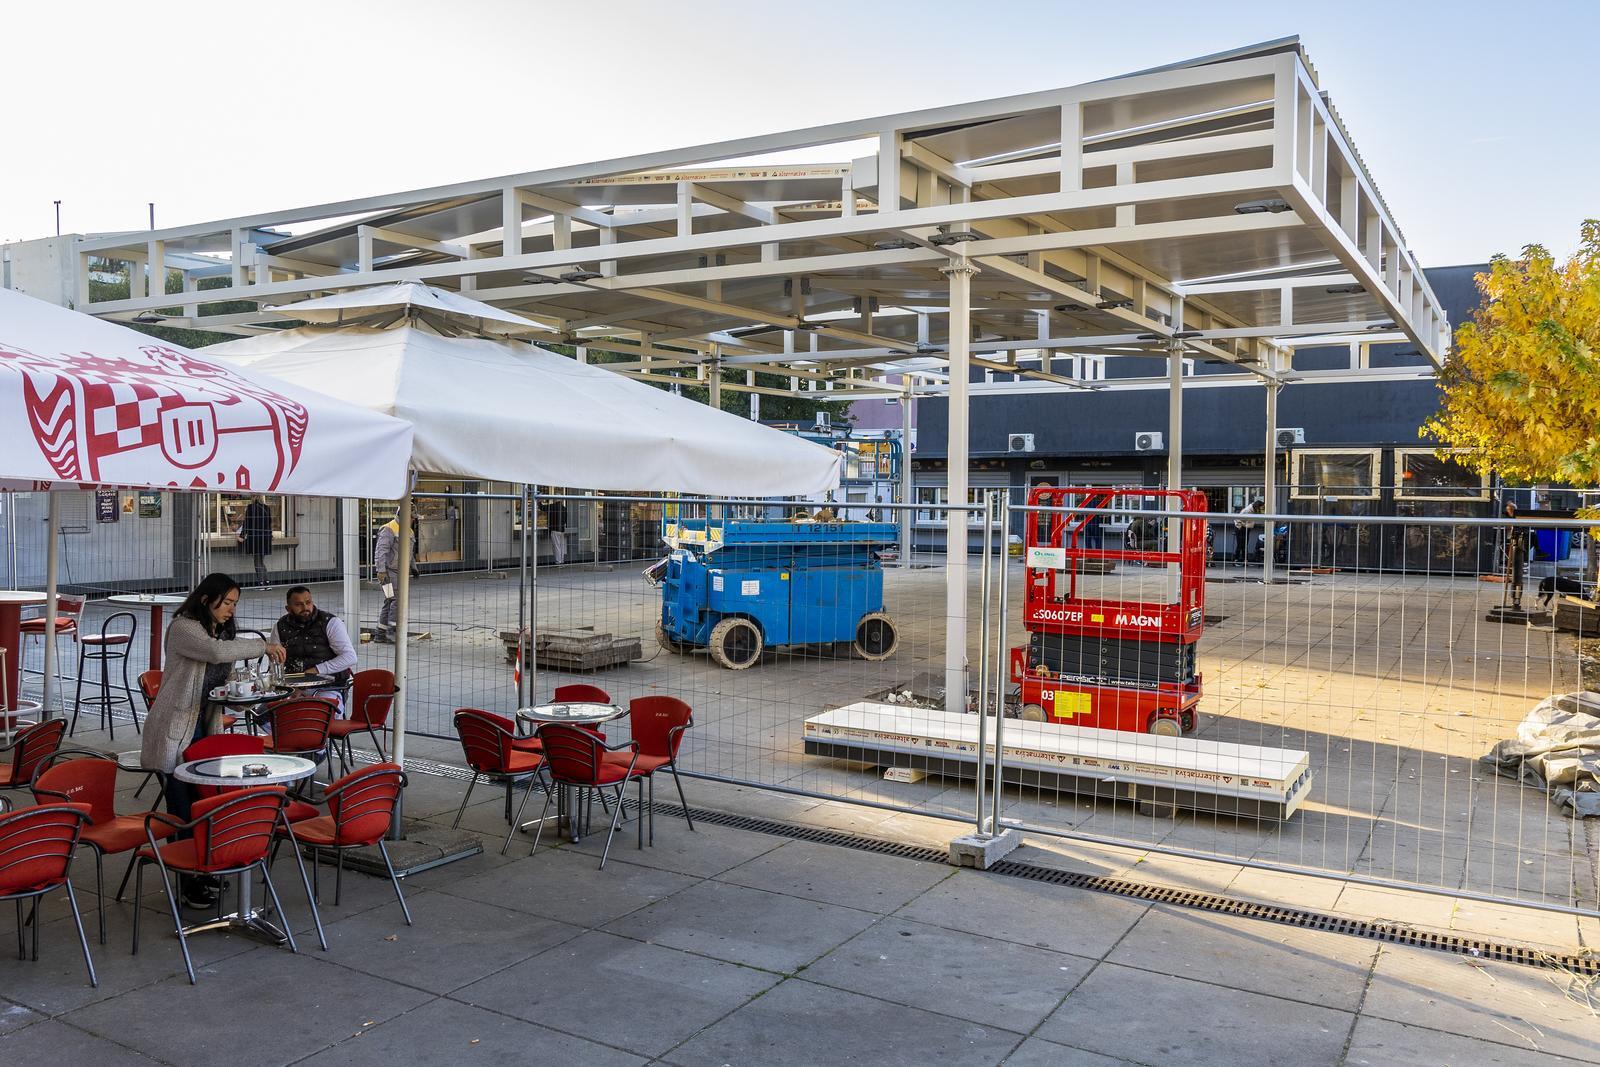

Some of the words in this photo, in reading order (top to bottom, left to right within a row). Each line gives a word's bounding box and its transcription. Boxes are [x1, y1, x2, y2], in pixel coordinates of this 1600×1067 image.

[1115, 614, 1162, 627] MAGNI
[1041, 690, 1054, 701] 03
[1015, 750, 1056, 761] alternativa
[1175, 769, 1221, 783] alternativa
